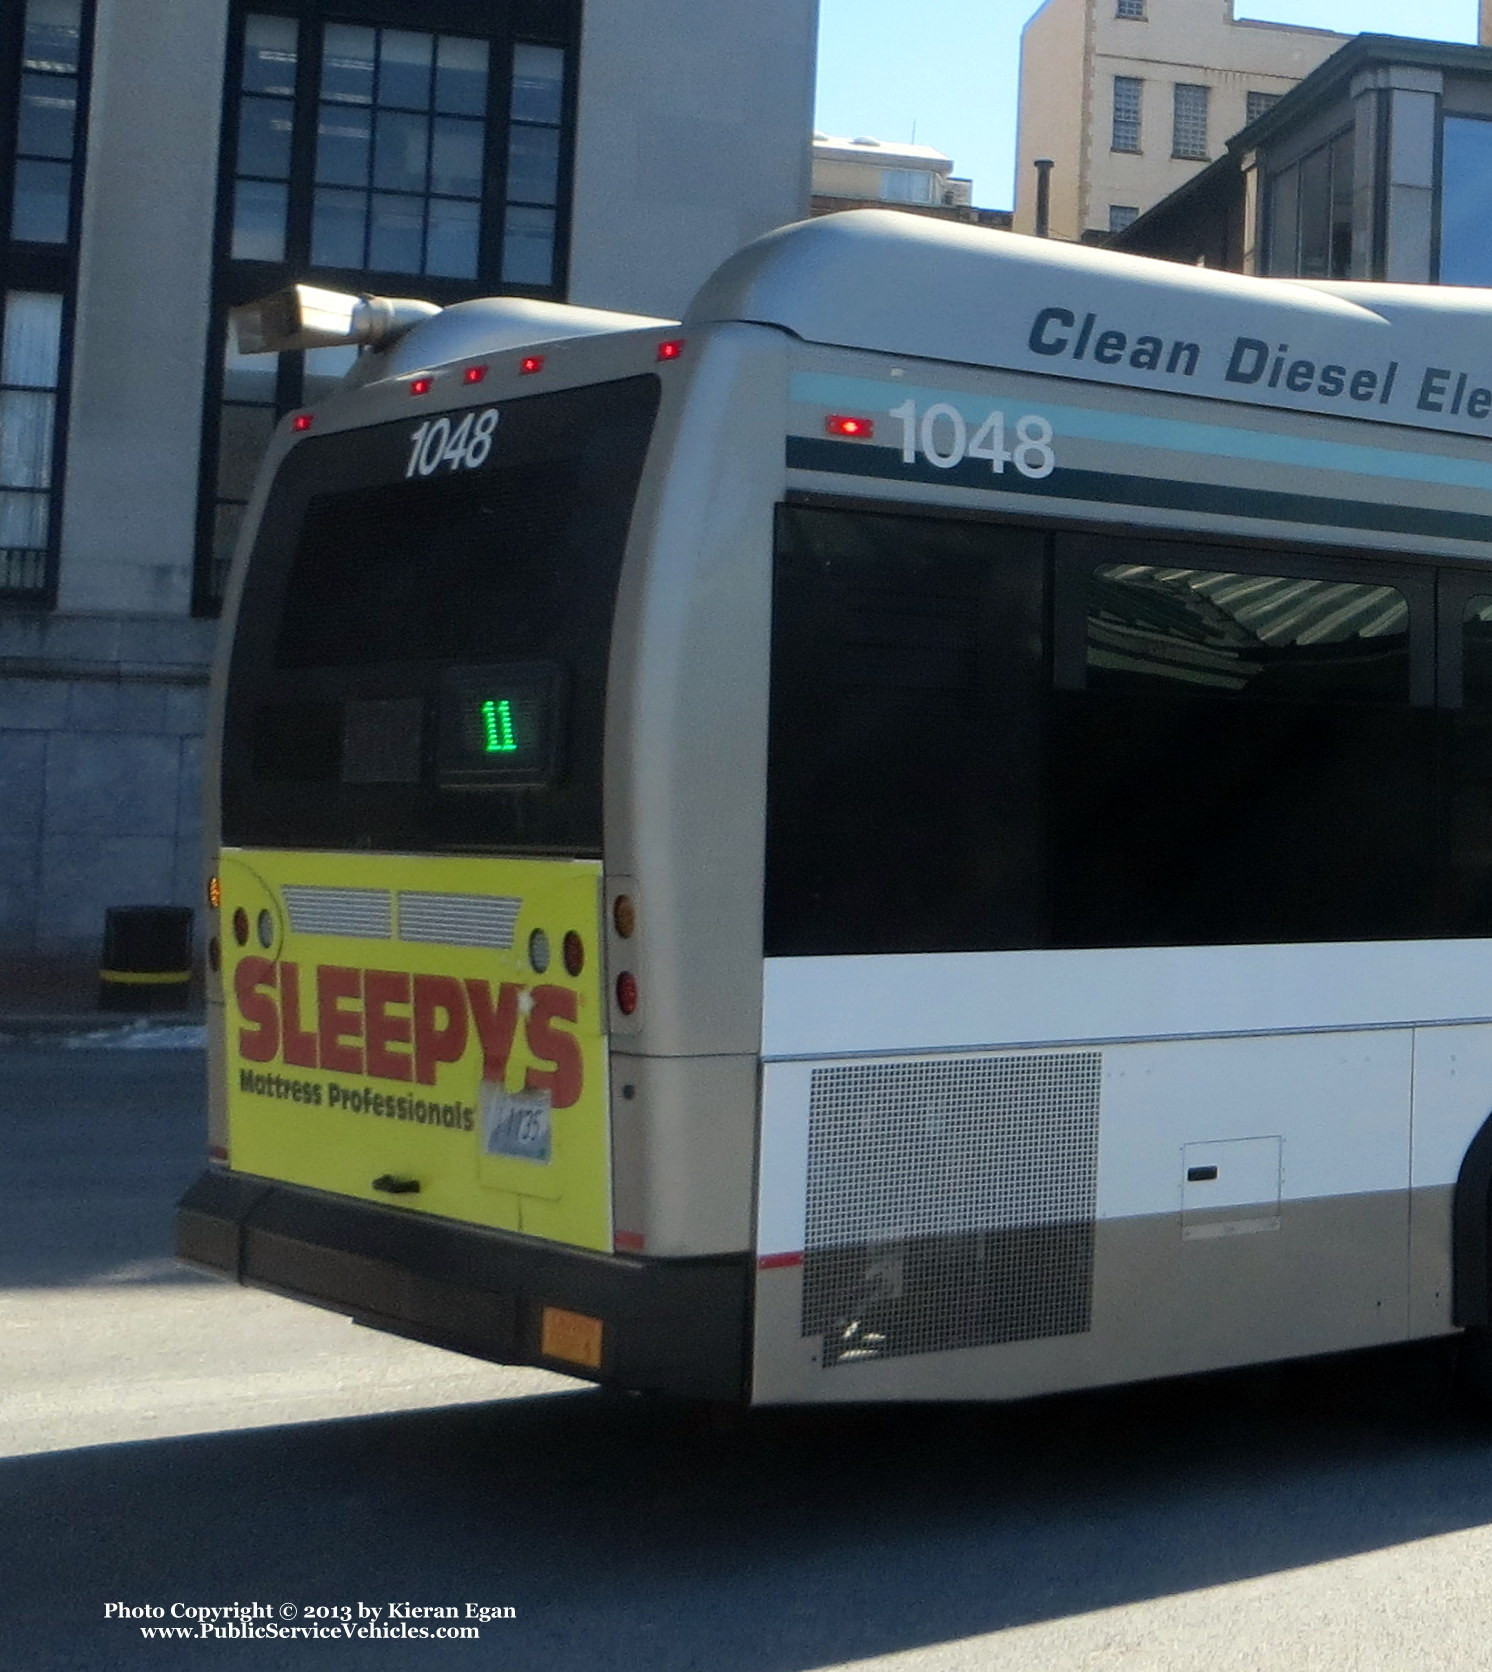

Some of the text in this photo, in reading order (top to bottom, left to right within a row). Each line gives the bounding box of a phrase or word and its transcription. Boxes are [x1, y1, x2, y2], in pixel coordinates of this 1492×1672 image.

[1028, 307, 1200, 377] Clean
[1225, 337, 1399, 405] Diesel
[405, 408, 500, 478] 1048
[889, 399, 1055, 479] 1048
[481, 700, 517, 751] 11
[239, 1068, 476, 1132] Mattress Professionals
